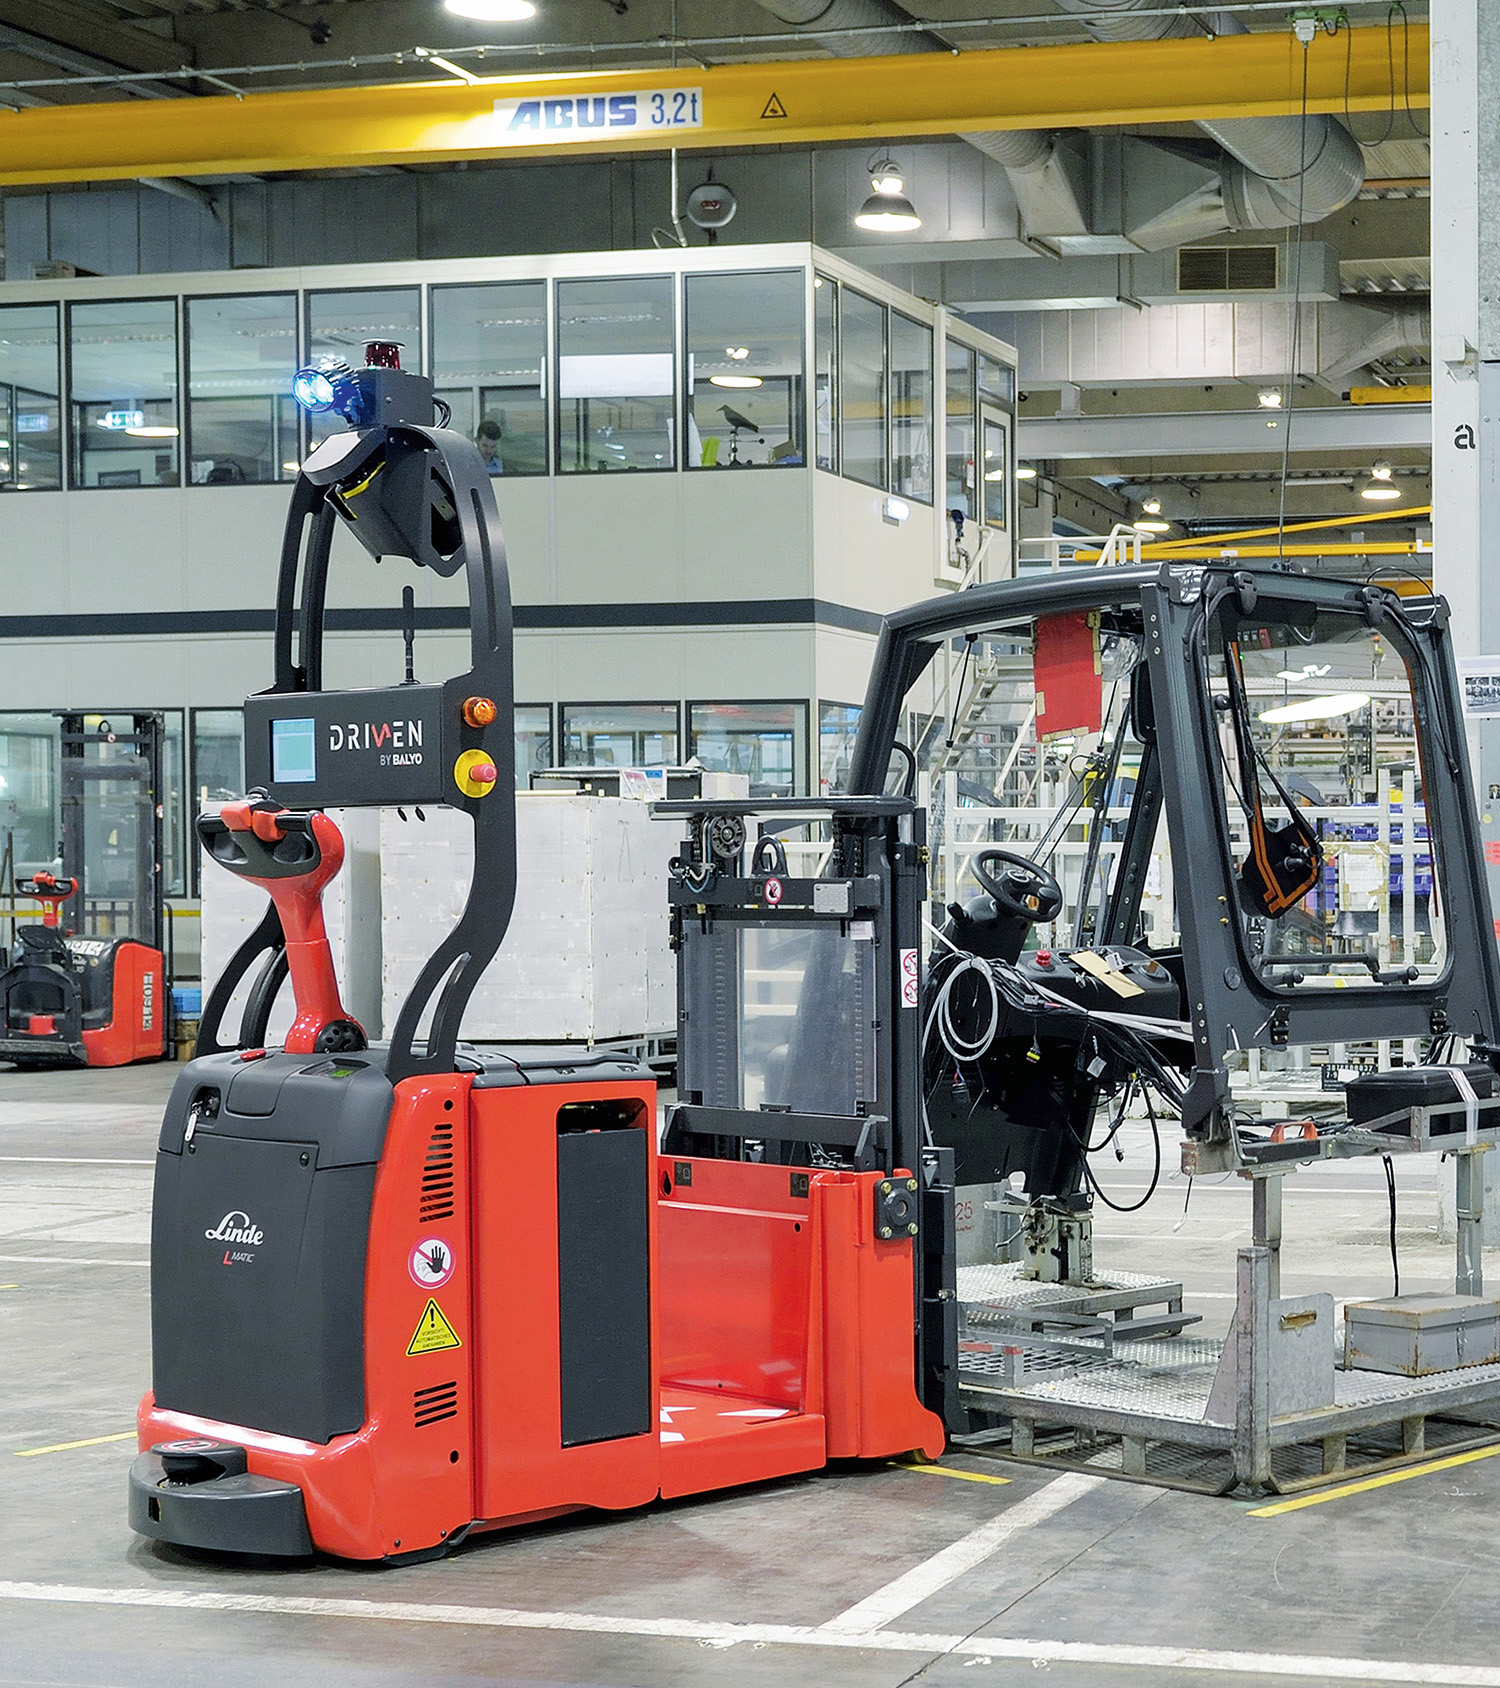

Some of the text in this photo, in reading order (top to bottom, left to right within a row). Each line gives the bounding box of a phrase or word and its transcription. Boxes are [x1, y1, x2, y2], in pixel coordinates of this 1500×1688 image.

[506, 95, 637, 131] ABUS
[1454, 424, 1476, 449] a
[329, 719, 423, 751] DRIVEN
[380, 752, 423, 766] BY BALYO
[205, 1211, 264, 1246] Linde
